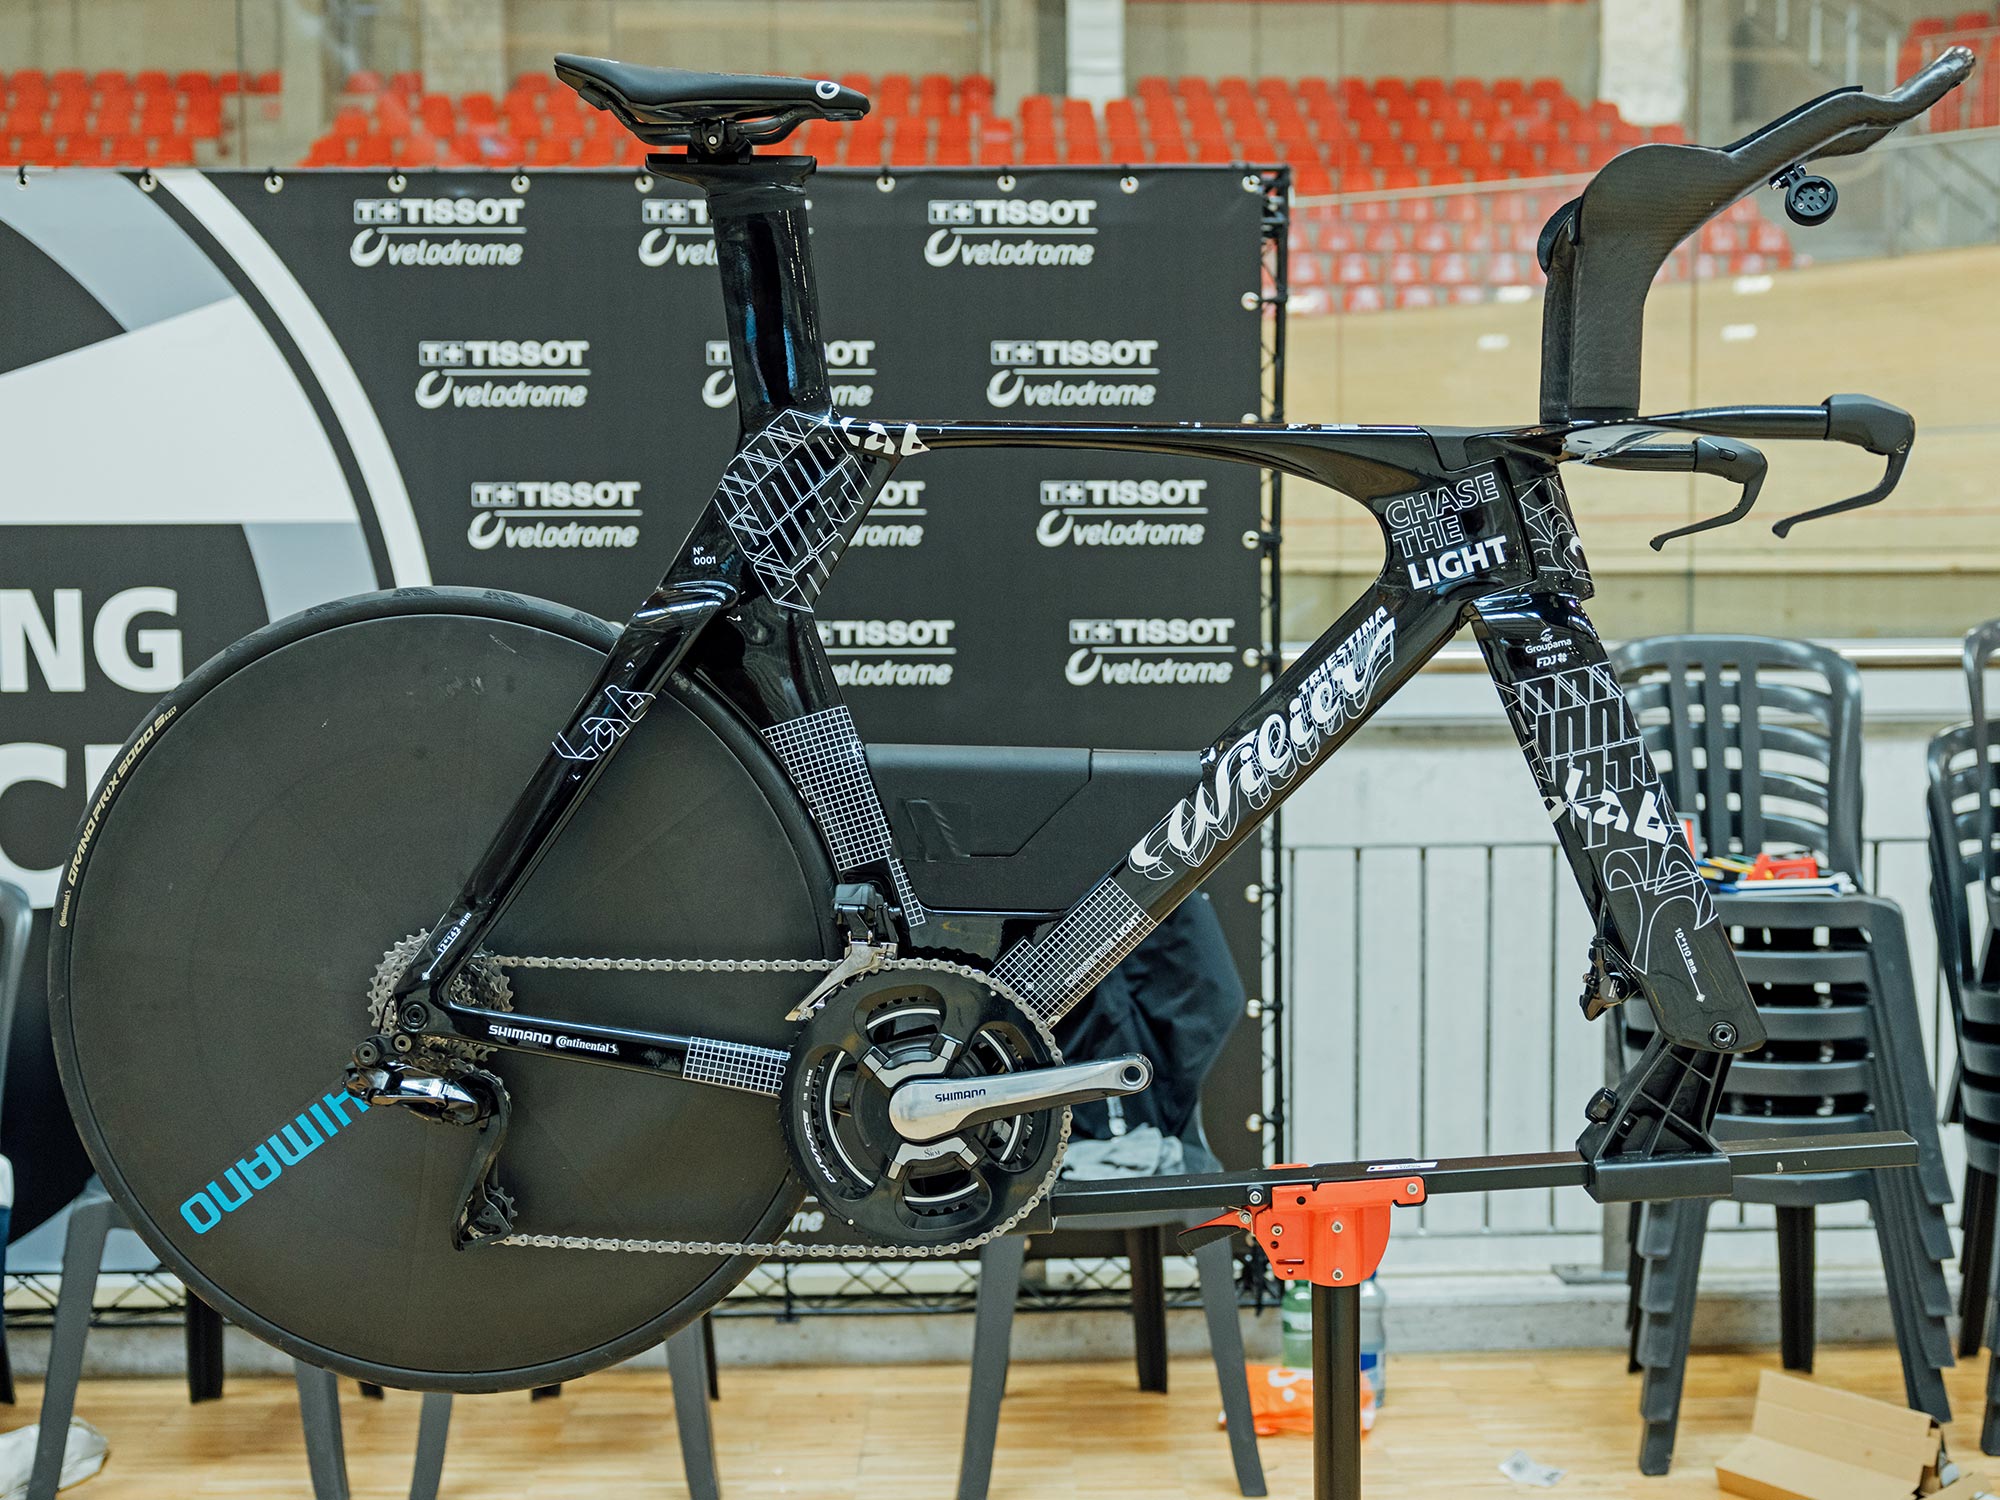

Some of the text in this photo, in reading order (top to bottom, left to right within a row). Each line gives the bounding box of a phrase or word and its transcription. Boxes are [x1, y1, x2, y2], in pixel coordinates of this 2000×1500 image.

[387, 237, 524, 266] velodrome
[960, 239, 1095, 266] velodrome
[452, 379, 587, 408] velodrome
[1023, 379, 1157, 406] velodrome
[1385, 471, 1500, 529] CHASE
[504, 520, 640, 549] velodrome
[1073, 519, 1205, 546] velodrome
[1392, 515, 1465, 558] THE
[693, 556, 717, 566] 0001
[1408, 535, 1507, 591] LIGHT
[1298, 605, 1389, 693] TRIESTINA
[1525, 637, 1572, 655] Groupama
[831, 659, 954, 686] elodrome
[1102, 658, 1234, 685] velodrome
[1536, 655, 1558, 669] FDJ
[67, 820, 96, 887] GRAND
[91, 772, 120, 822] PRIX
[116, 725, 155, 778] 5000
[488, 1024, 611, 1053] SHIMANO Continental
[180, 1087, 373, 1235] HIMANO
